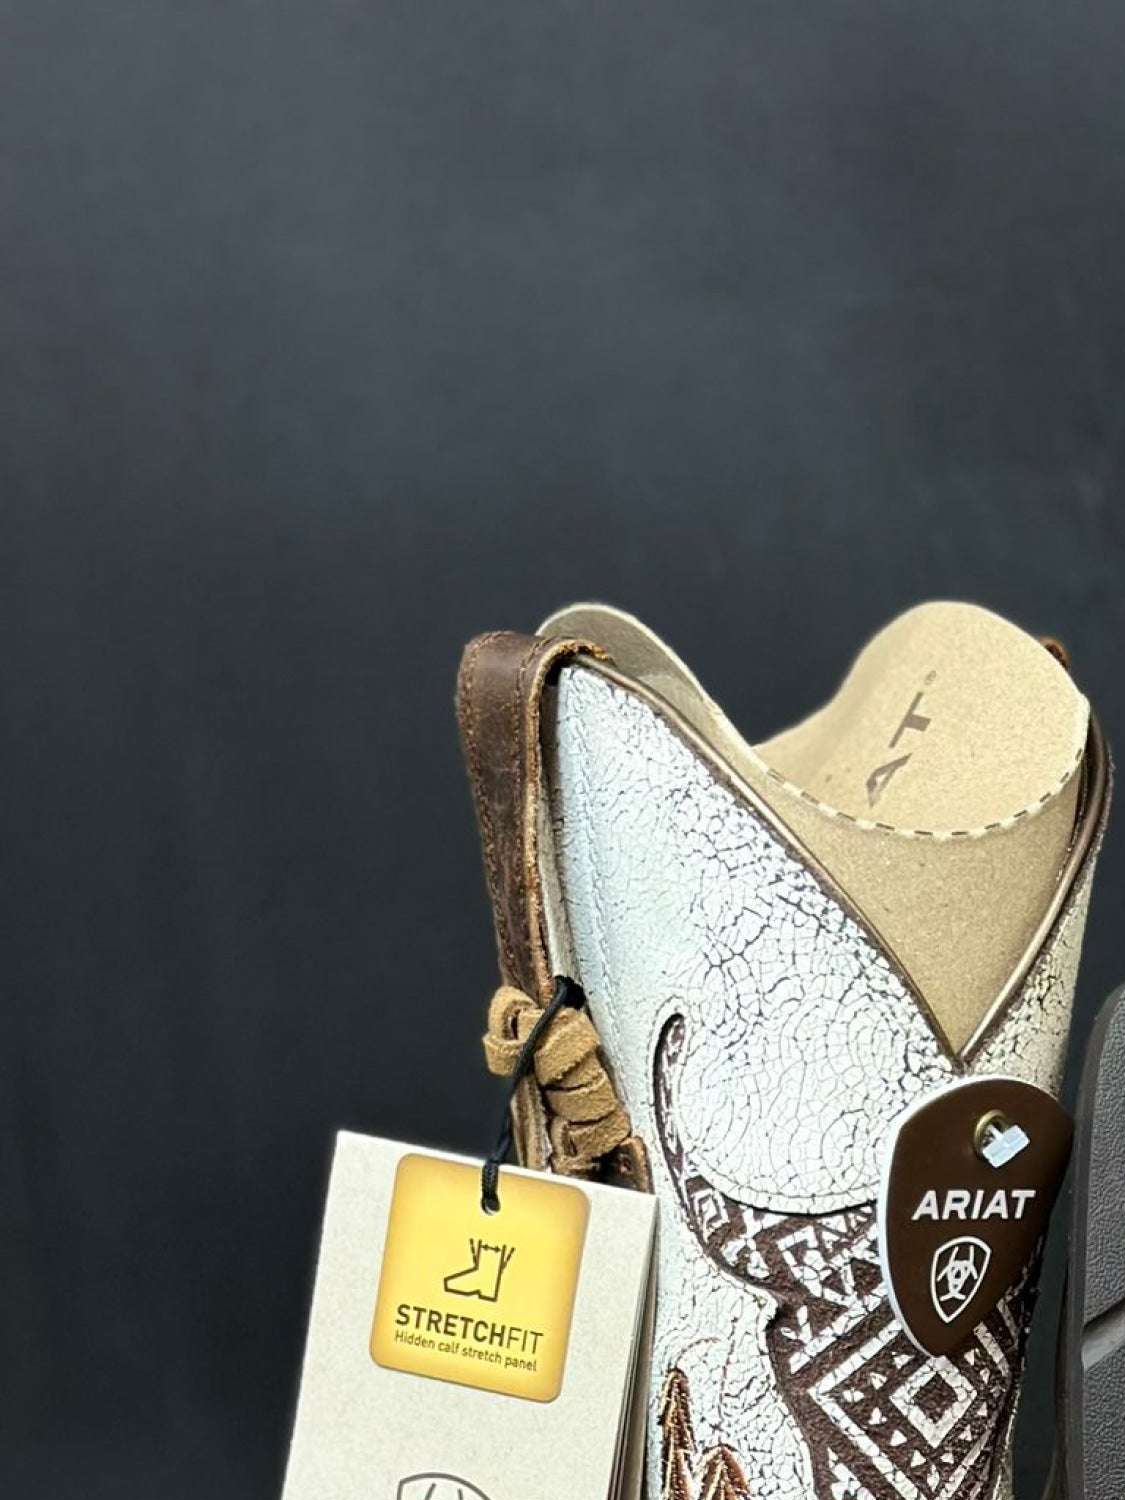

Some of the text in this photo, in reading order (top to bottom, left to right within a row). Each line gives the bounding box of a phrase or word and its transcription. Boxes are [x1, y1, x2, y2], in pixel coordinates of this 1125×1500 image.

[911, 1189, 1036, 1221] ARIAT
[395, 1303, 544, 1354] STRETCHFIT
[394, 1329, 538, 1372] Hidden calf stretch panel
